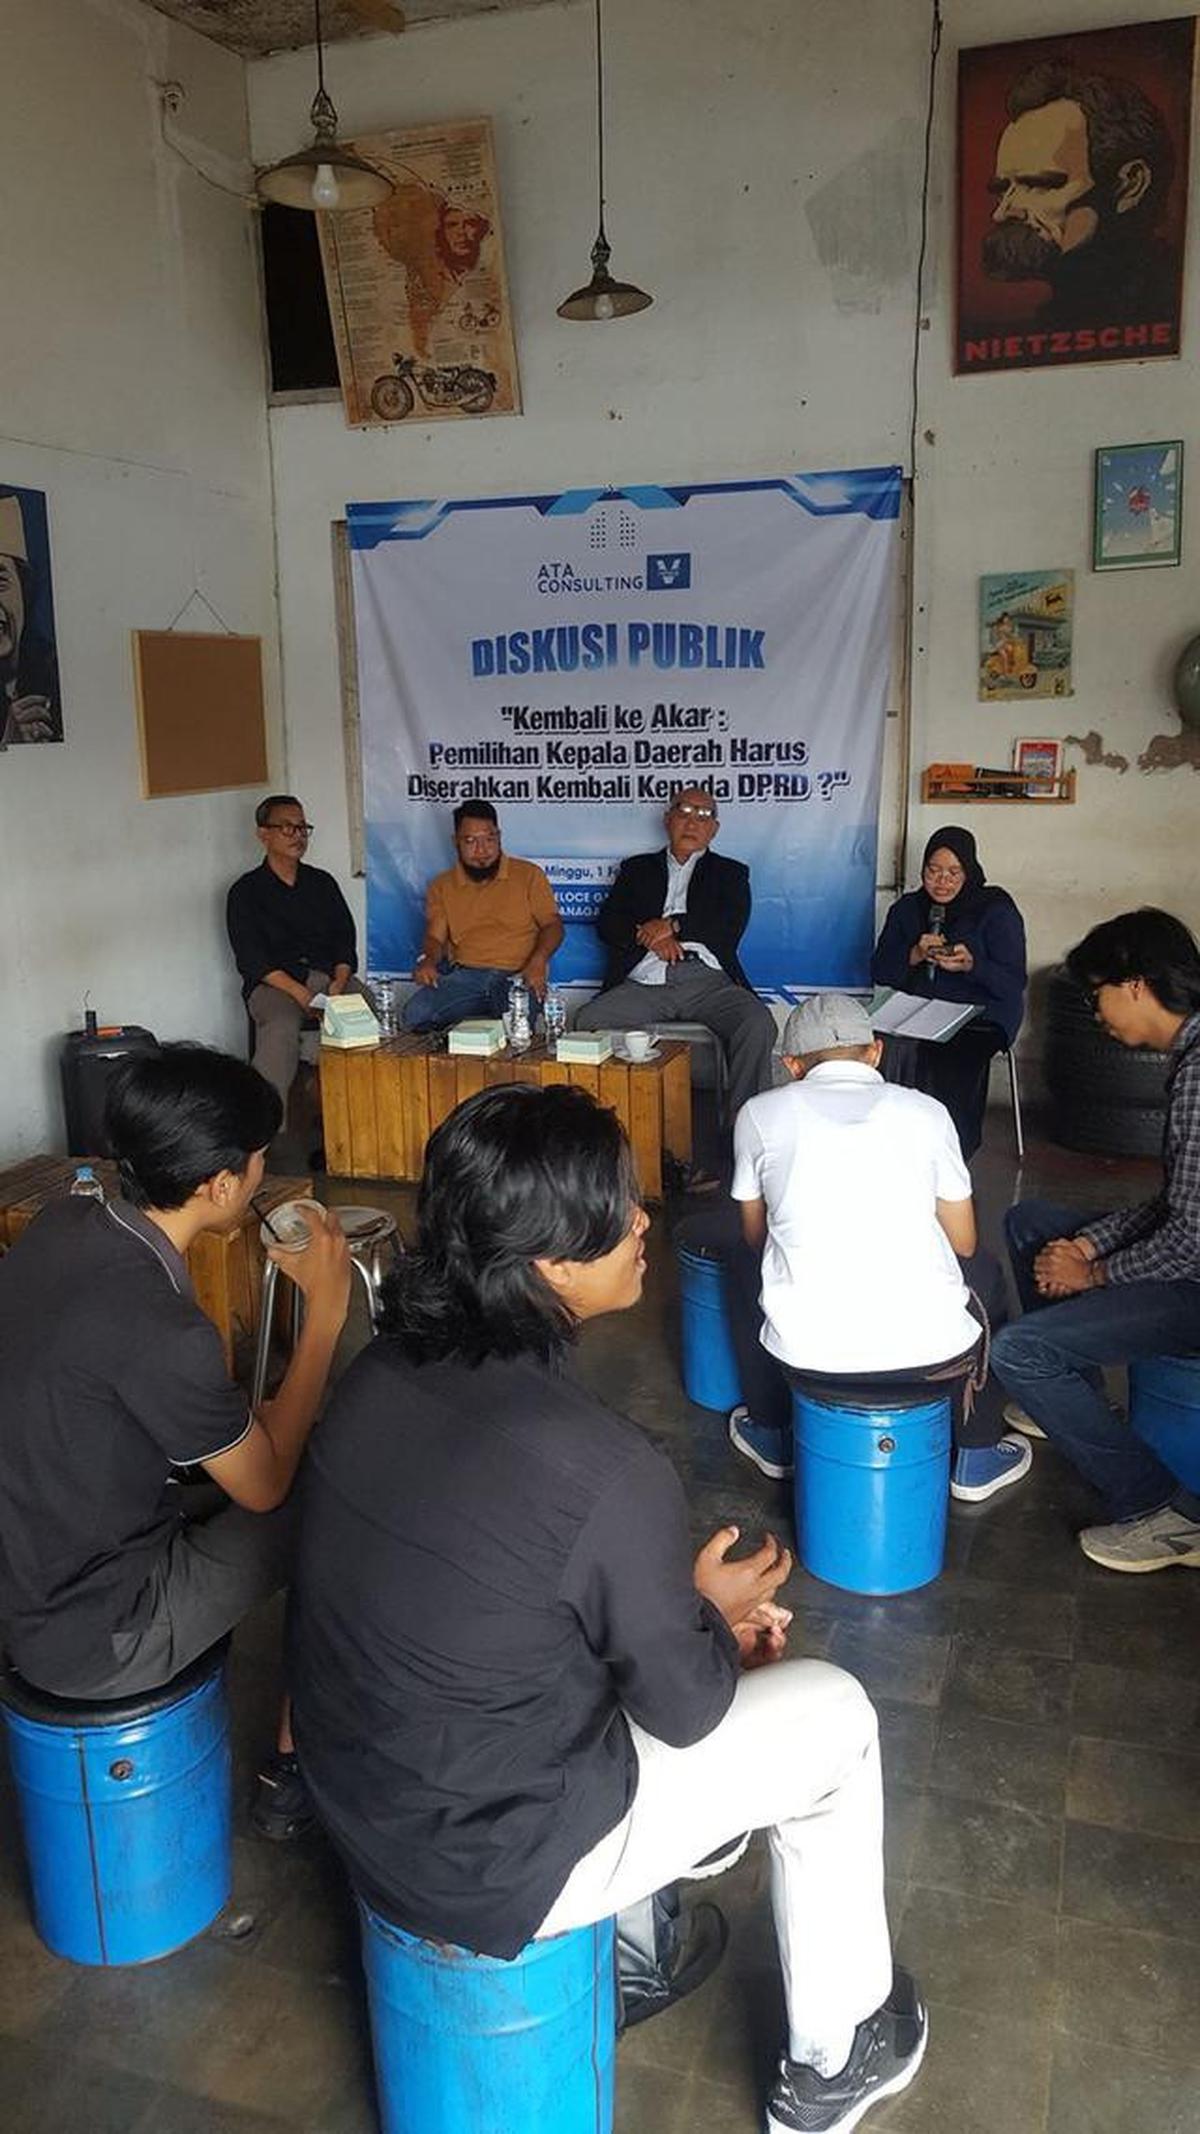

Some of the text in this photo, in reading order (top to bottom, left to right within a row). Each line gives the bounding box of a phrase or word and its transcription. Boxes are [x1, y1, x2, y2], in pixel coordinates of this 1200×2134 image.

[964, 323, 1171, 361] NIETZSCHE
[537, 563, 575, 578] ATA
[538, 576, 644, 594] CONSULTING
[472, 622, 766, 677] DISKUSI PUBLIK
[501, 705, 608, 734] "Kembali
[614, 705, 644, 730] ke
[650, 703, 713, 730] Akar
[429, 738, 808, 772] Pemilihan Kepala Daerah Harus
[408, 774, 531, 800] Diserahkan
[536, 775, 631, 800] Kembali
[737, 773, 812, 799] DPRD
[545, 865, 594, 880] Minggu,
